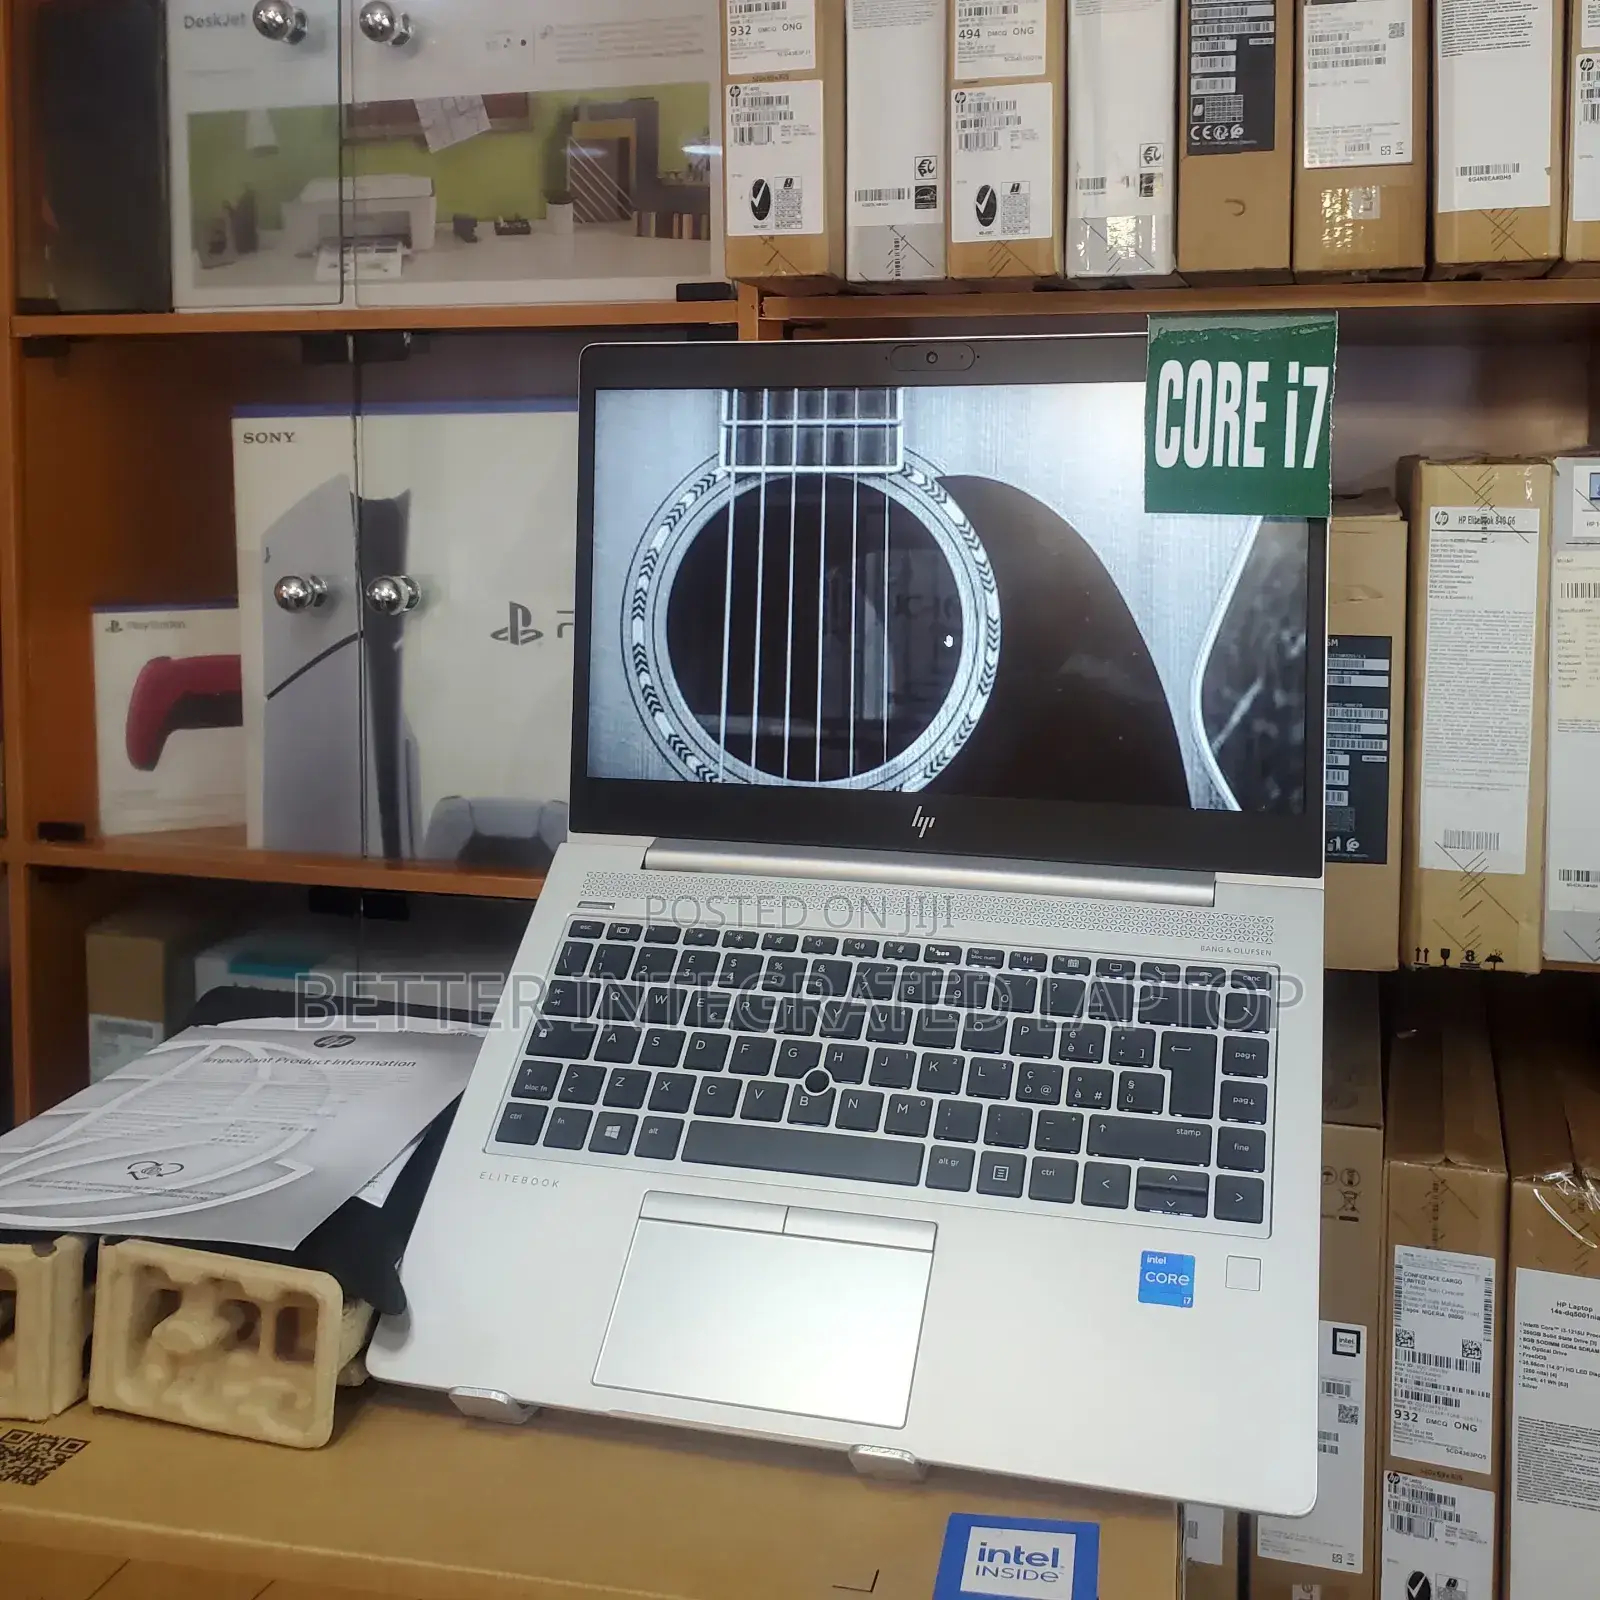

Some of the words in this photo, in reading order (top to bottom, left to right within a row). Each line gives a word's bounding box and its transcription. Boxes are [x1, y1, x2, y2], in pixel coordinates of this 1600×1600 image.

[730, 25, 751, 36] 932
[782, 22, 803, 32] ONG
[958, 28, 981, 39] 494
[1012, 26, 1035, 36] ONG
[1155, 359, 1269, 469] CORE
[1284, 361, 1329, 469] i7
[243, 431, 297, 444] SONY
[1458, 515, 1466, 525] HP
[911, 805, 936, 838] hp
[1200, 945, 1224, 953] BANG
[1233, 947, 1272, 956] OLUFSEN
[687, 955, 696, 963] £
[729, 958, 738, 968] $
[640, 965, 648, 974] 2
[773, 961, 783, 970] %
[817, 964, 826, 973] &
[682, 968, 691, 977] 3
[726, 972, 734, 981] 4
[1242, 974, 1262, 982] canc
[770, 975, 778, 984] 5
[815, 978, 823, 987] 6
[861, 981, 869, 990] 7
[906, 985, 915, 995] 8
[610, 991, 620, 1001] Q
[655, 994, 668, 1005] W
[953, 989, 962, 999] 9
[696, 997, 705, 1008] E
[740, 1001, 750, 1012] R
[786, 1004, 795, 1014] T
[833, 1008, 842, 1018] Y
[878, 1012, 888, 1023] U
[973, 1021, 984, 1031] O
[1020, 1025, 1030, 1036] P
[607, 1032, 617, 1043] A
[1069, 1029, 1077, 1038] é
[651, 1036, 661, 1047] S
[695, 1040, 706, 1051] D
[740, 1043, 751, 1054] F
[788, 1047, 798, 1058] G
[1067, 1043, 1075, 1052] è
[833, 1051, 844, 1062] H
[1234, 1051, 1251, 1060] pag
[202, 1055, 274, 1065] Important
[275, 1056, 330, 1066] Product
[331, 1058, 417, 1068] Information
[880, 1056, 889, 1067] J
[928, 1061, 940, 1072] K
[1001, 1062, 1007, 1070] 3
[977, 1066, 986, 1077] L
[1026, 1069, 1034, 1080] ç
[615, 1076, 626, 1087] Z
[660, 1081, 671, 1092] X
[706, 1084, 717, 1095] C
[754, 1088, 765, 1100] V
[1024, 1085, 1032, 1094] ò
[1040, 1084, 1052, 1096] @
[1074, 1089, 1082, 1099] à
[799, 1096, 809, 1107] B
[847, 1098, 859, 1109] N
[1232, 1096, 1249, 1105] pag
[897, 1103, 909, 1115] M
[509, 1112, 523, 1121] ctrl
[557, 1117, 565, 1125] fn
[648, 1126, 659, 1135] alt
[1176, 1126, 1201, 1137] stamp
[1233, 1142, 1250, 1152] fine
[938, 1157, 949, 1165] alt
[950, 1159, 960, 1167] gr
[1041, 1168, 1056, 1177] ctrl
[479, 1171, 560, 1188] ELITEBOOK
[1146, 1254, 1167, 1265] intel
[1403, 1271, 1440, 1282] CONFIDENCE
[1441, 1277, 1463, 1285] CARGO
[1183, 1296, 1192, 1305] i7
[1556, 1300, 1567, 1308] HP
[1568, 1302, 1593, 1314] Laptop
[1573, 1337, 1589, 1345] Drive
[1522, 1352, 1547, 1361] FreeDOS
[1531, 1345, 1552, 1354] Optical
[1552, 1349, 1568, 1357] Drive
[1575, 1368, 1588, 1376] LED
[1521, 1382, 1539, 1390] Silver
[1393, 1409, 1419, 1423] 932
[1425, 1418, 1448, 1427] DMCQ
[1453, 1421, 1478, 1432] ONG
[977, 1541, 1060, 1569] intel
